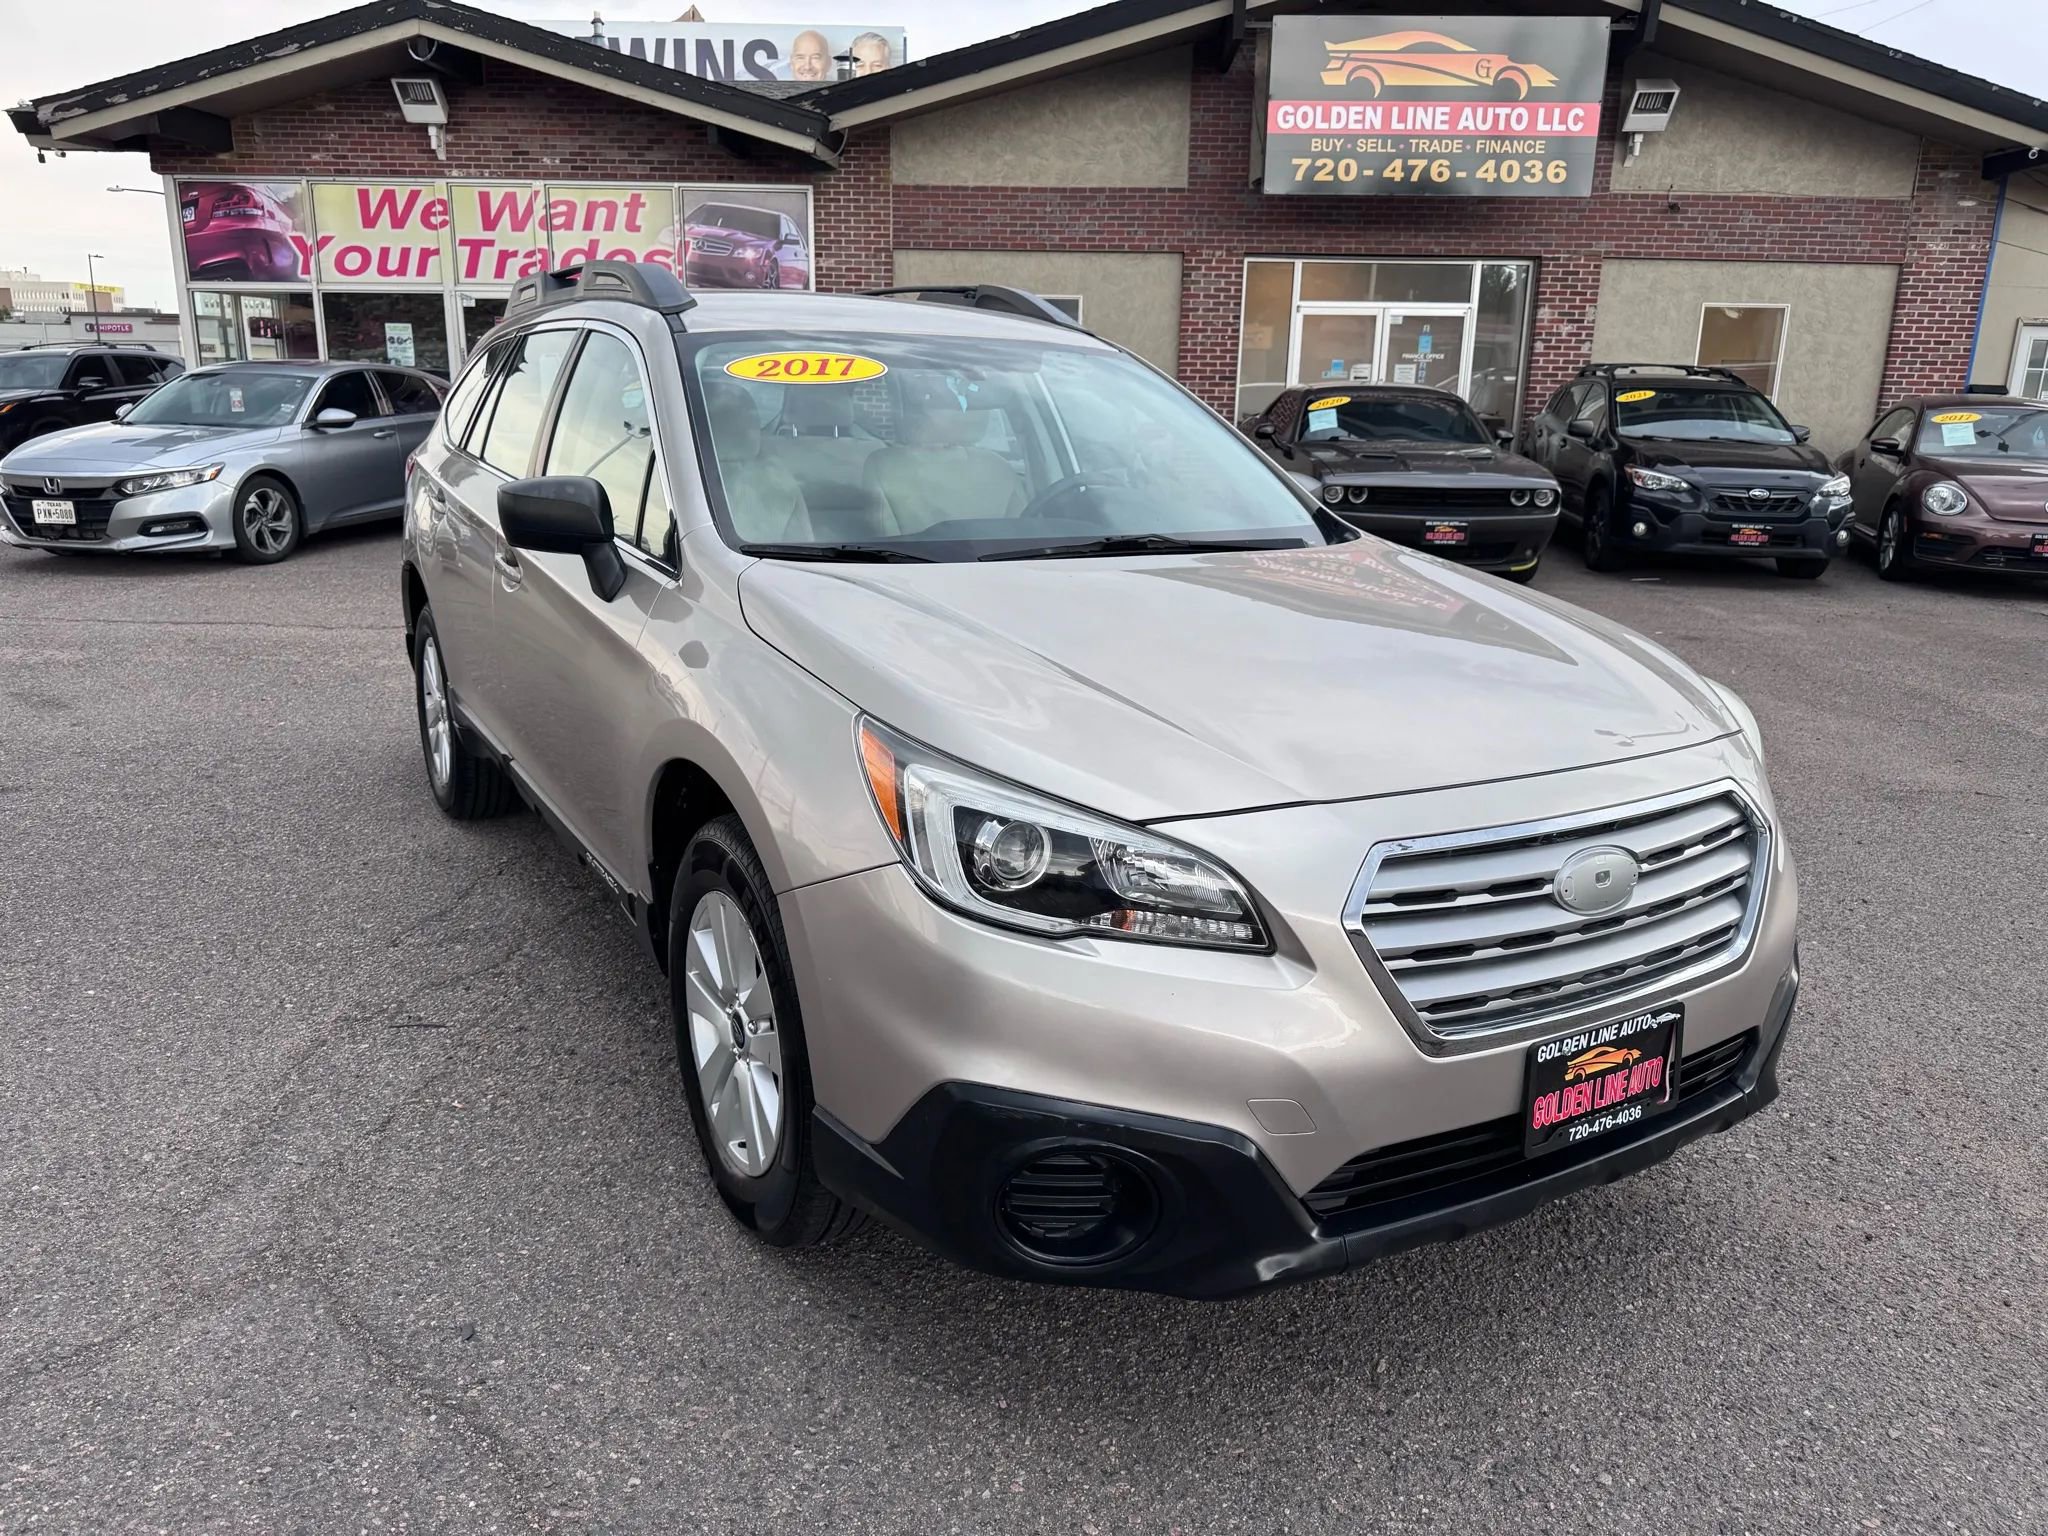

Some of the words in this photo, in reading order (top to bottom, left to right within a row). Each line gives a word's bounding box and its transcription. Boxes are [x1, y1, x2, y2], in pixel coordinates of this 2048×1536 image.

[1277, 105, 1382, 130] GOLDEN
[1391, 106, 1449, 130] LINE
[1457, 107, 1529, 131] AUTO
[1537, 107, 1585, 132] LLC
[1311, 138, 1345, 152] BUY
[1356, 138, 1396, 152] SELL
[1409, 139, 1463, 153] TRADE
[1475, 139, 1546, 154] FINANCE
[357, 188, 449, 231] We
[478, 190, 646, 233] Want
[289, 235, 440, 278] Your
[94, 324, 130, 332] CHIPOTLE
[756, 358, 856, 377] 2017
[1538, 1033, 1588, 1062] GOLDEN
[1590, 1023, 1620, 1045] LINE
[1619, 1013, 1652, 1036] AUTO
[1533, 1080, 1592, 1128] GOLDEN
[1594, 1068, 1629, 1109] LINE
[1627, 1056, 1664, 1098] AUTO
[1568, 1105, 1642, 1141] 720-476-4036
